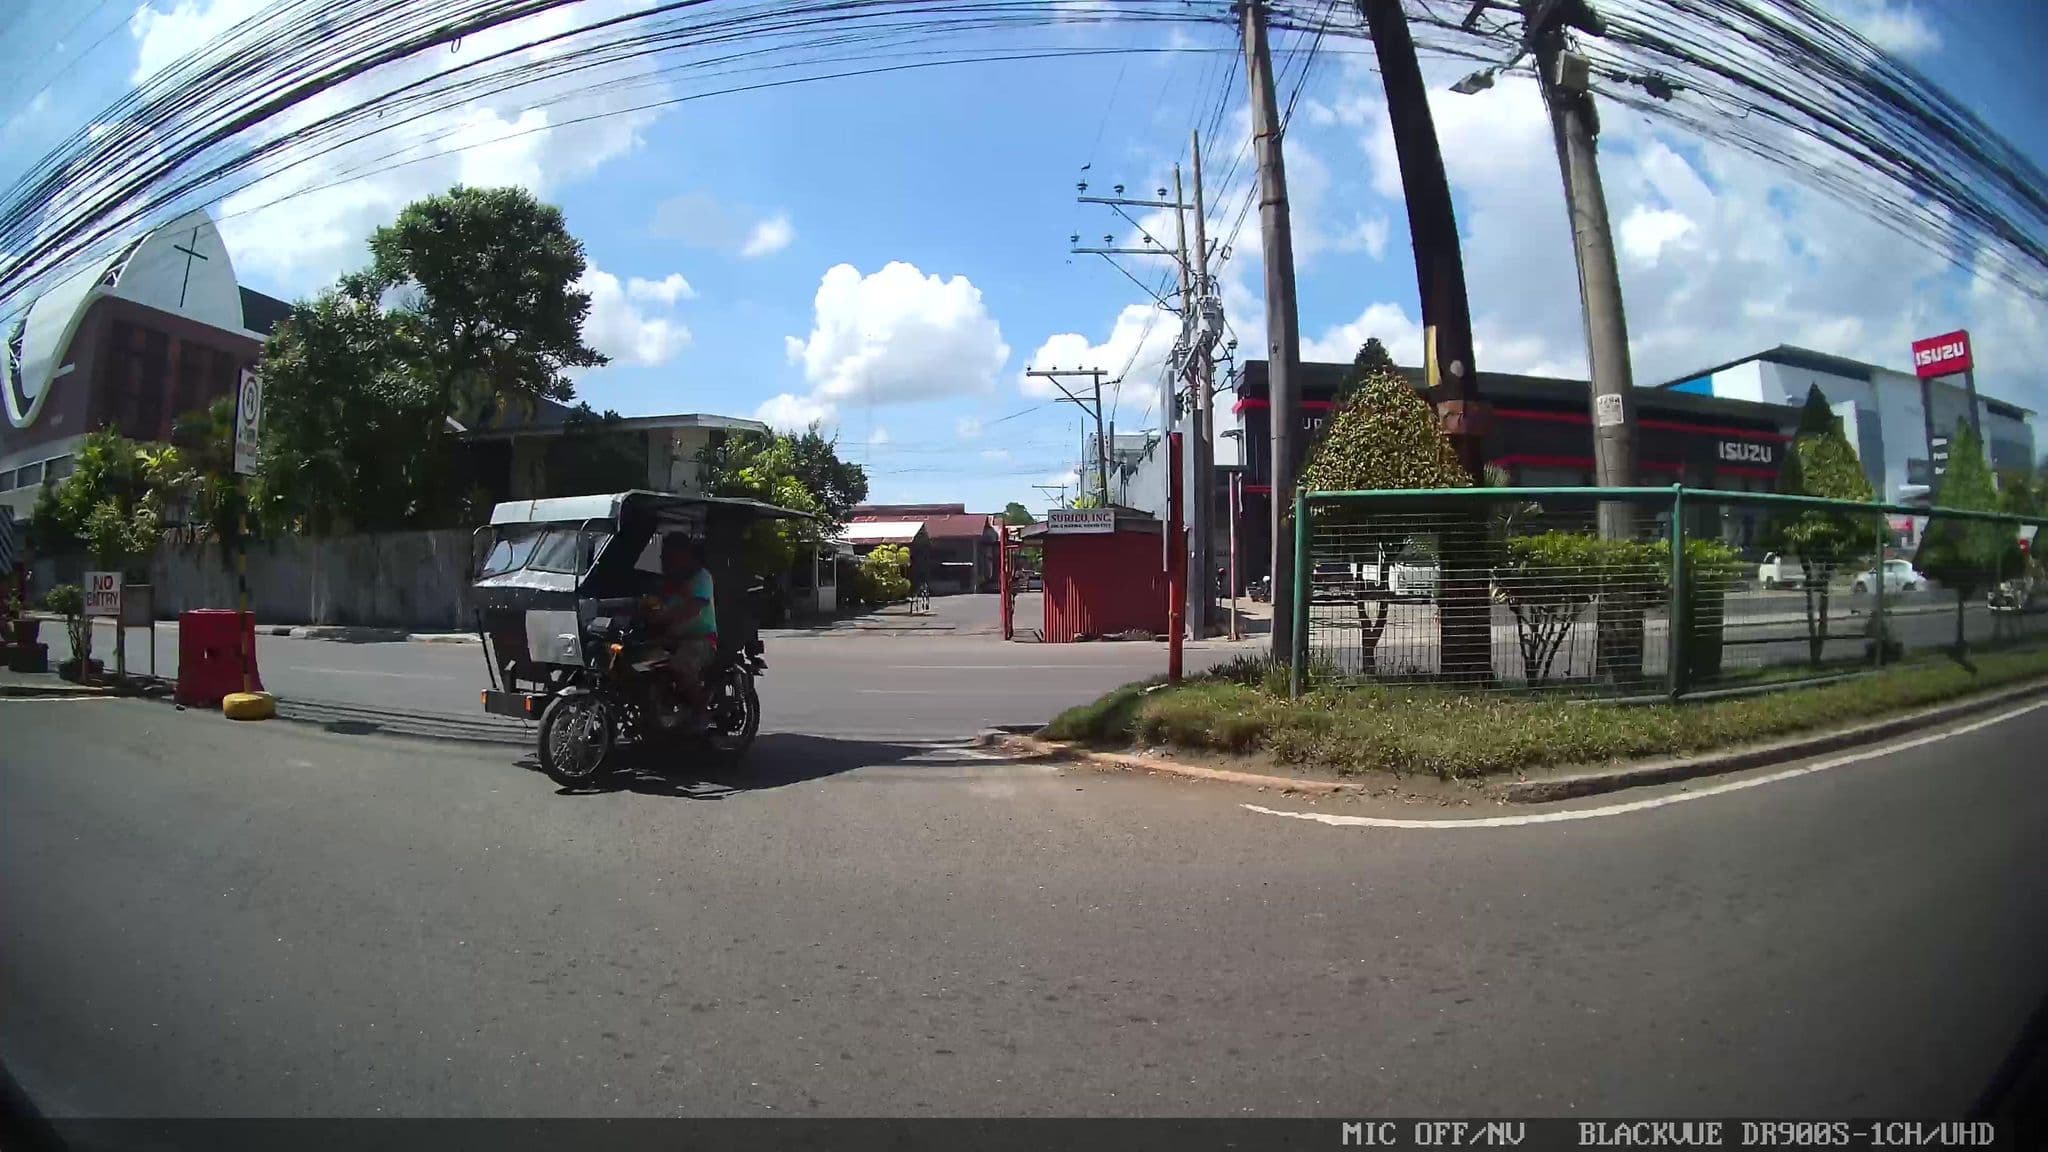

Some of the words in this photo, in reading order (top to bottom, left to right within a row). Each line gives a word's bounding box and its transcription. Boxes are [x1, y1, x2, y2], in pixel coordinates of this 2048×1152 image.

[1915, 341, 1965, 367] ISUZU
[1719, 440, 1772, 463] ISUZU
[93, 575, 114, 591] NO
[86, 591, 118, 607] ENTRY
